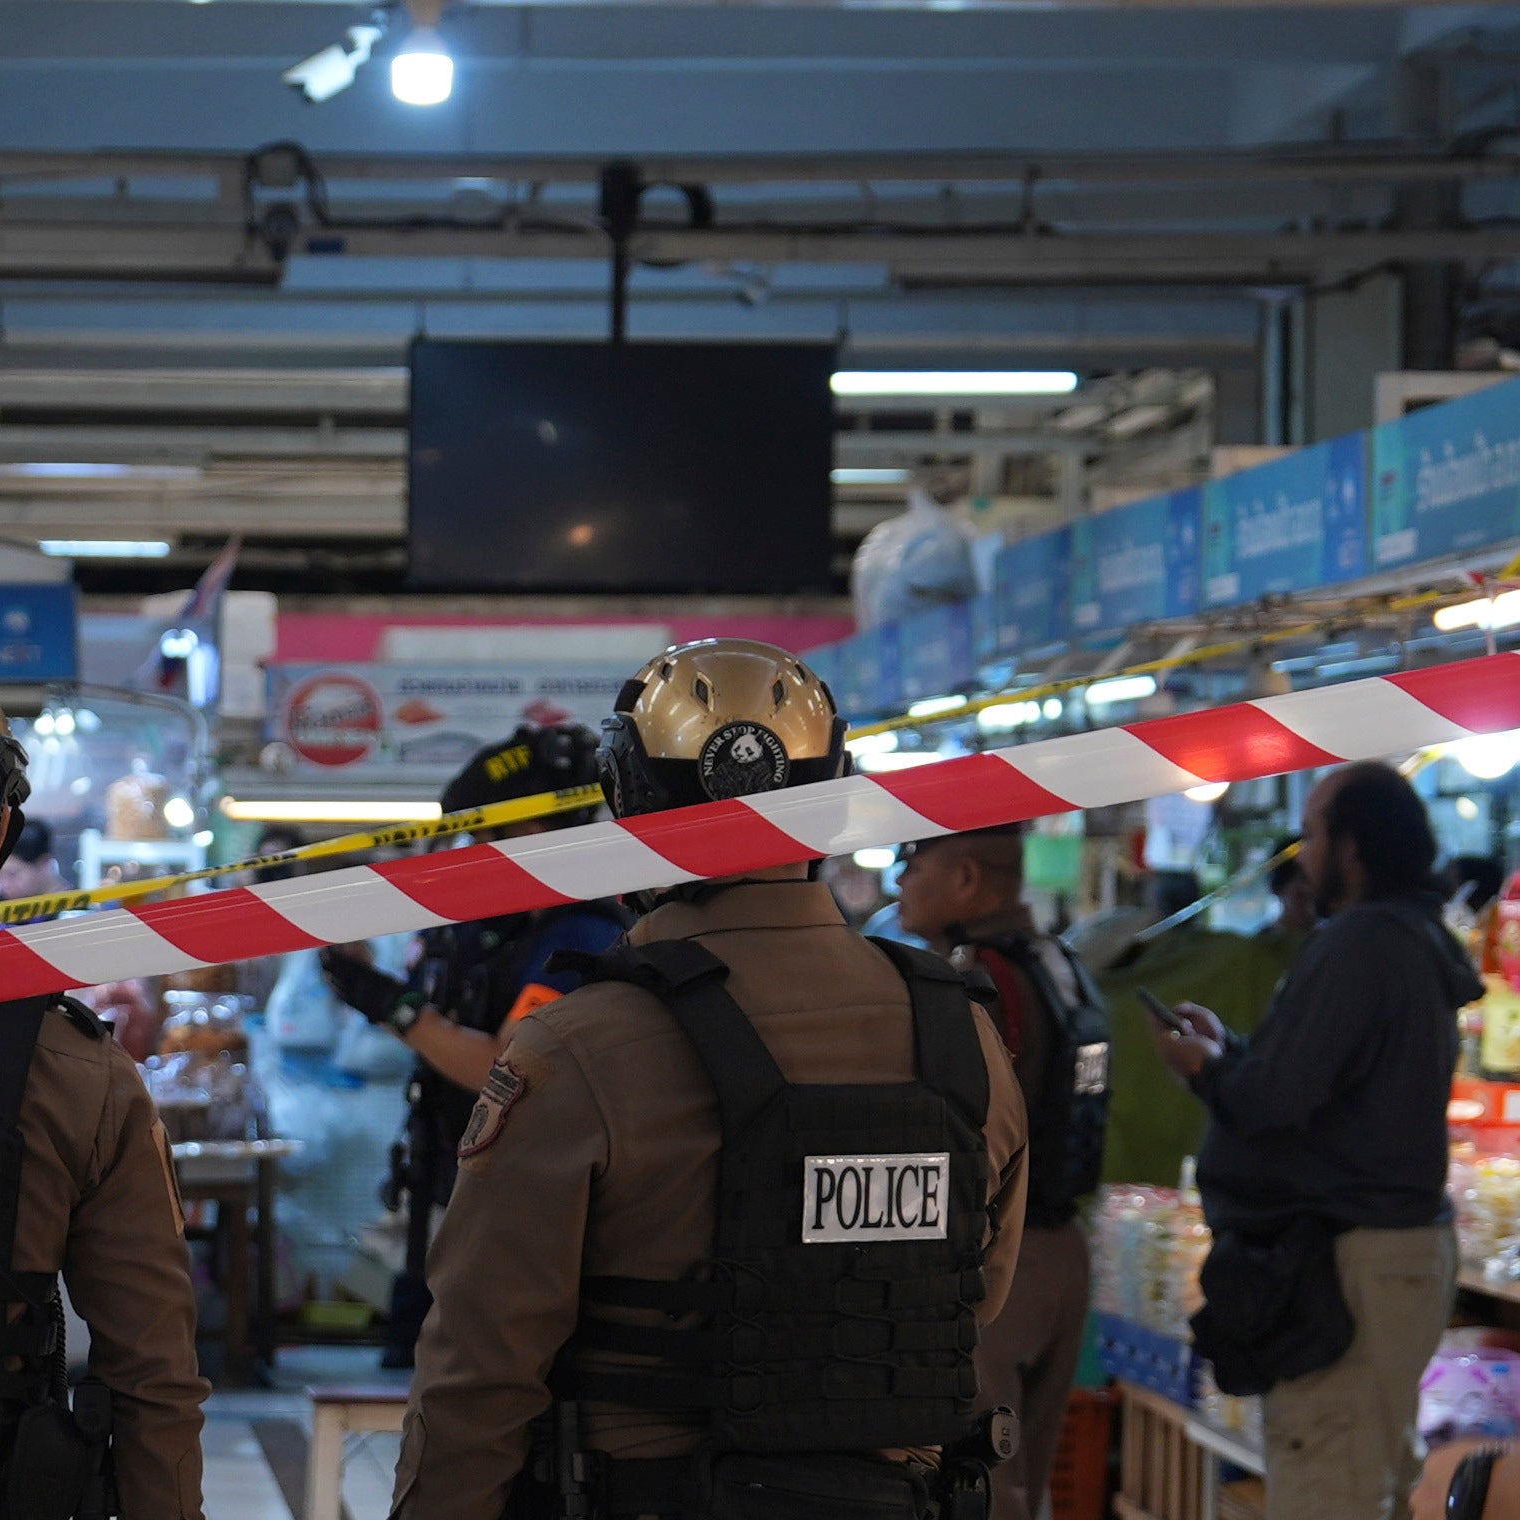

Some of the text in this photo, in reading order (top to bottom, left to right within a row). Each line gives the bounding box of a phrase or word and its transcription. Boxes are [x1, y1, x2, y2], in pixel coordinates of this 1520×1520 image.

[703, 726, 785, 783] NEVER STOP FIGHTING
[811, 1164, 941, 1231] POLICE
